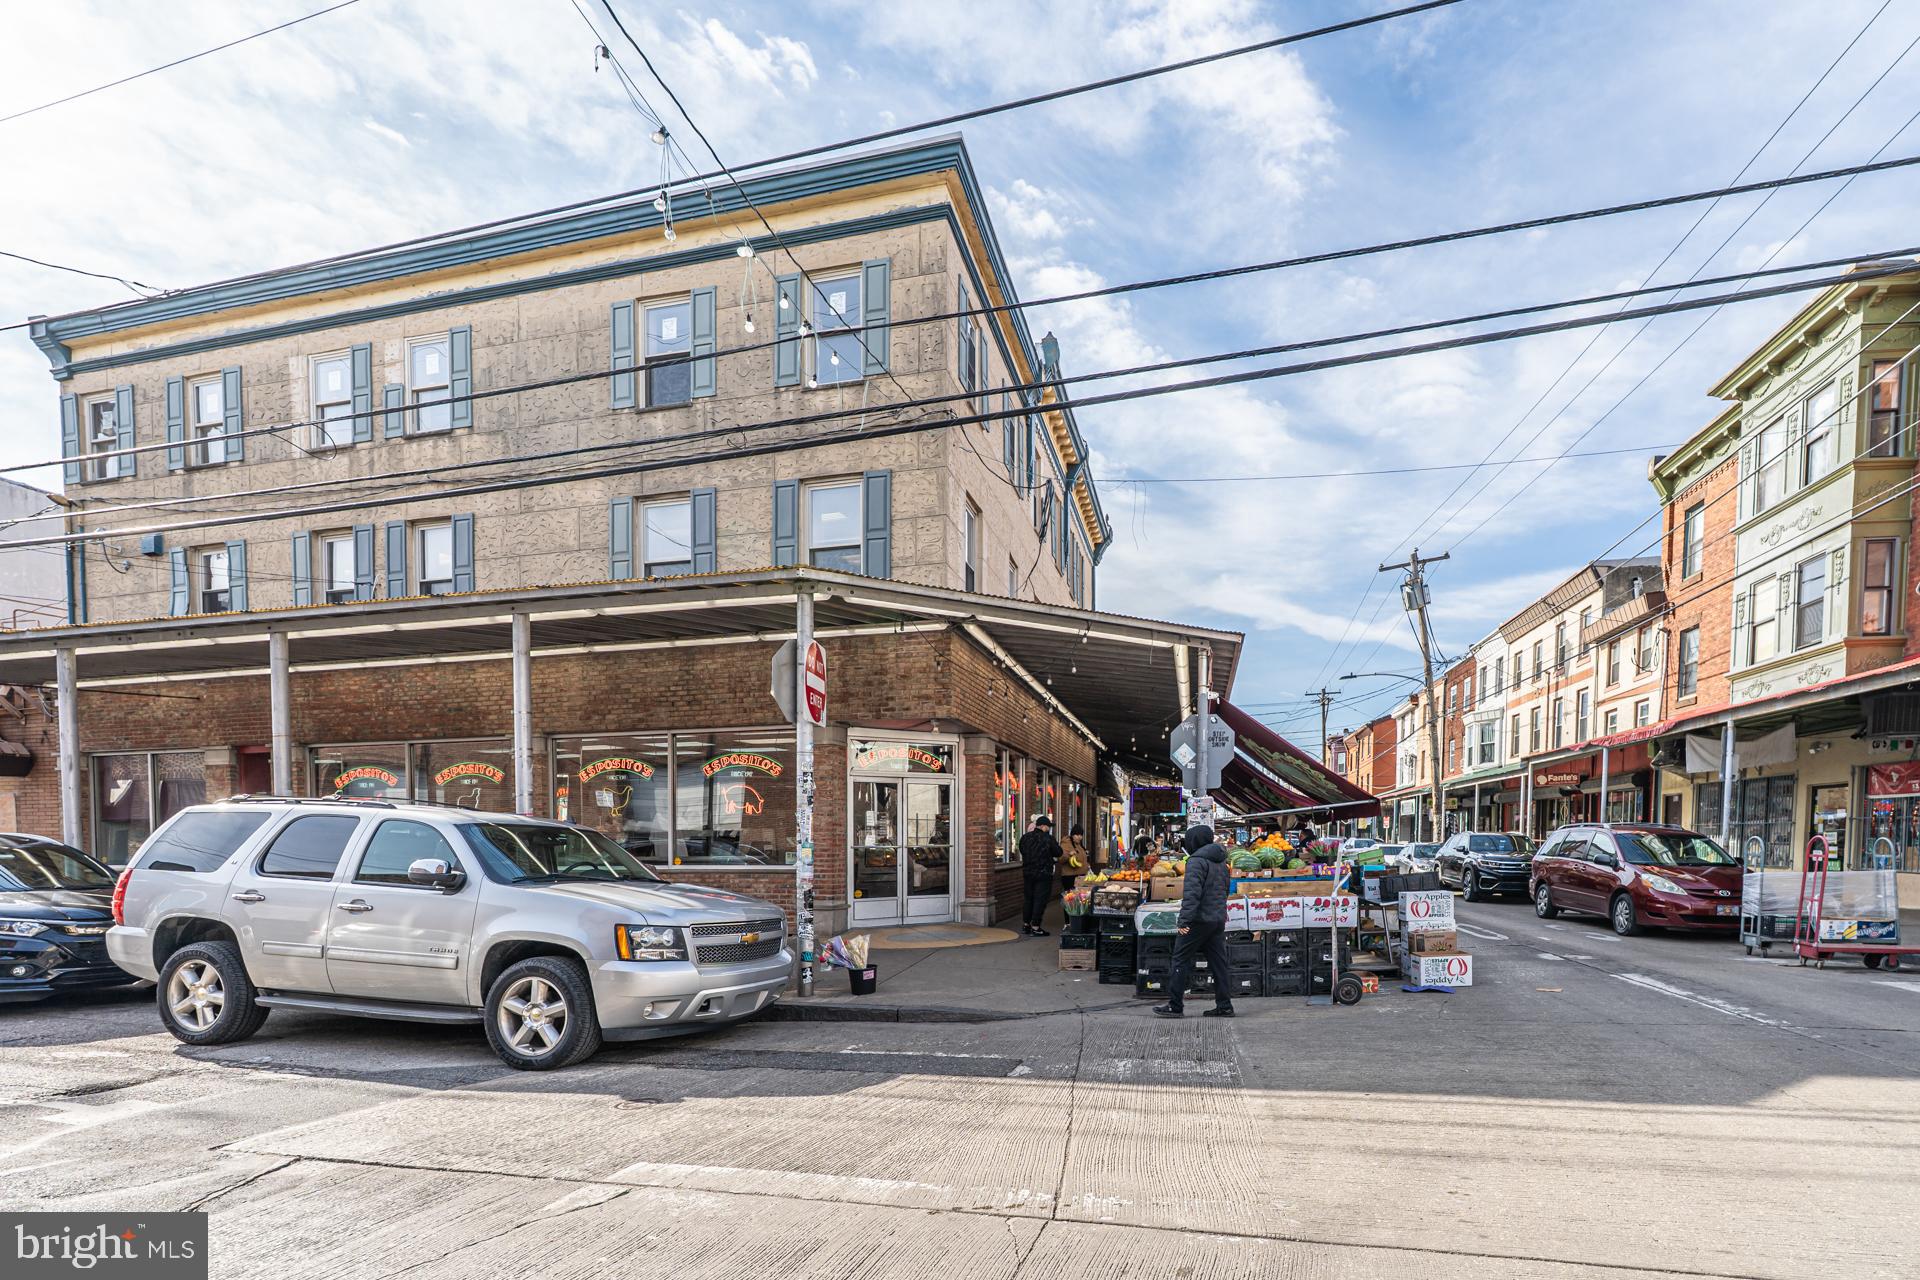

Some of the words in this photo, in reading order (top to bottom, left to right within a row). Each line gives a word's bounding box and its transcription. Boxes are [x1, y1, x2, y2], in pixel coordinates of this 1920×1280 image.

[808, 655, 815, 670] DO
[816, 660, 824, 675] NOT
[810, 692, 822, 709] ENTER
[703, 753, 783, 778] ESPOSITO'S
[858, 747, 942, 770] ESPOSITO'S
[335, 767, 398, 788] ESPOSITO'S
[434, 763, 506, 786] ESPOSITO'S
[579, 758, 654, 783] ESPOSITO'S
[1424, 893, 1451, 901] Apples
[1424, 977, 1454, 985] Apples
